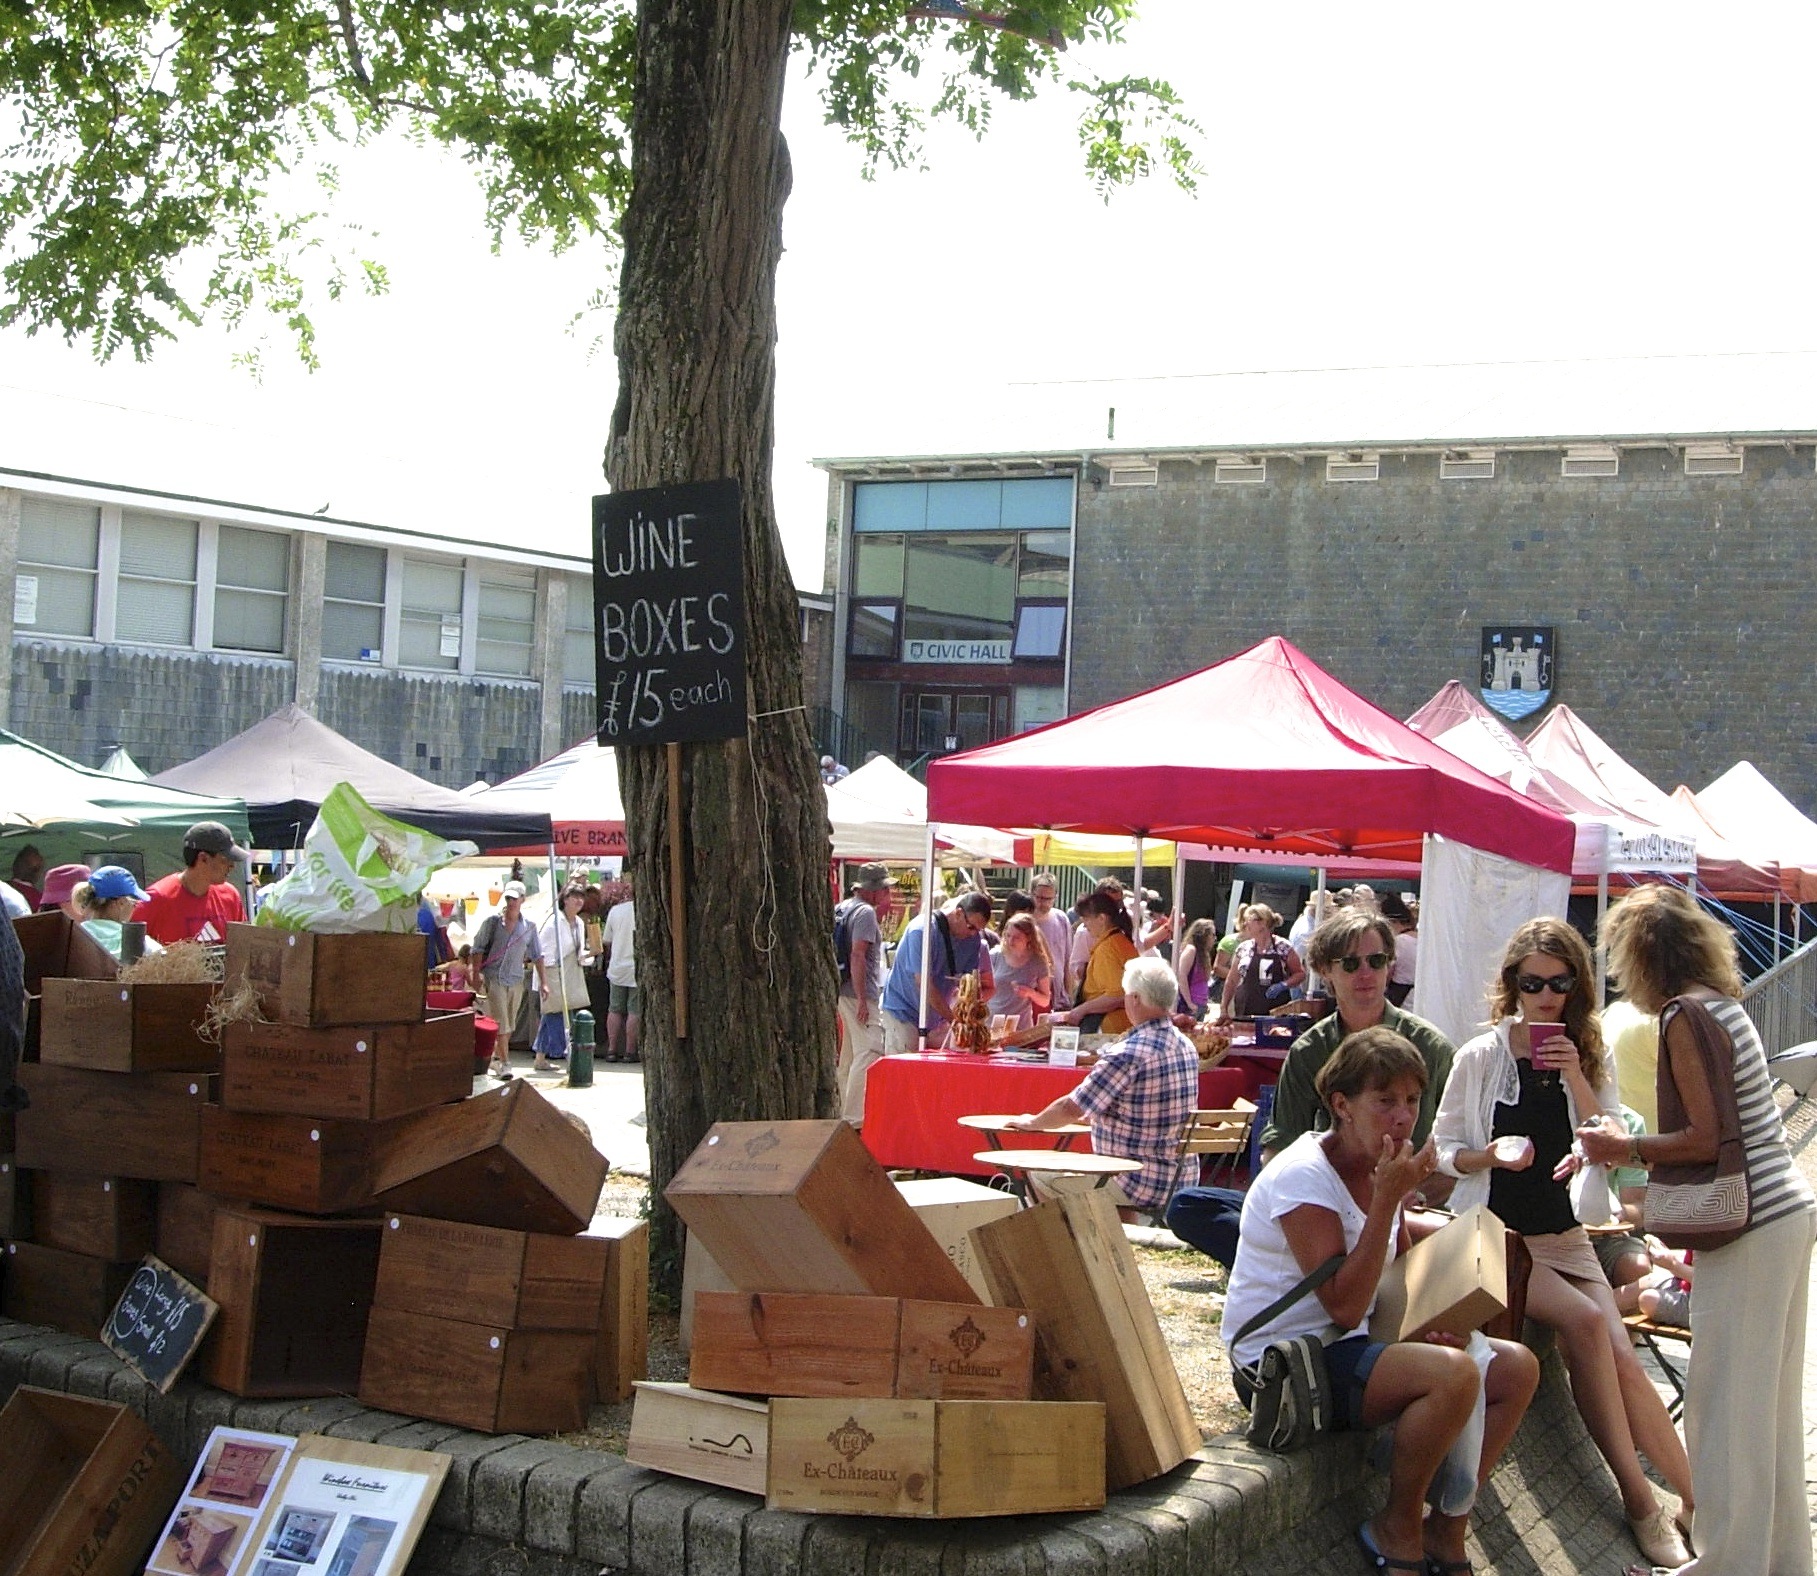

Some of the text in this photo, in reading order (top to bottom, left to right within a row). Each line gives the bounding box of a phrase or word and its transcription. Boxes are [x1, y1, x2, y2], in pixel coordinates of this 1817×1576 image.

[603, 592, 735, 662] BOXES
[927, 644, 1007, 659] CIVIC HALL
[599, 668, 732, 735] £15 each
